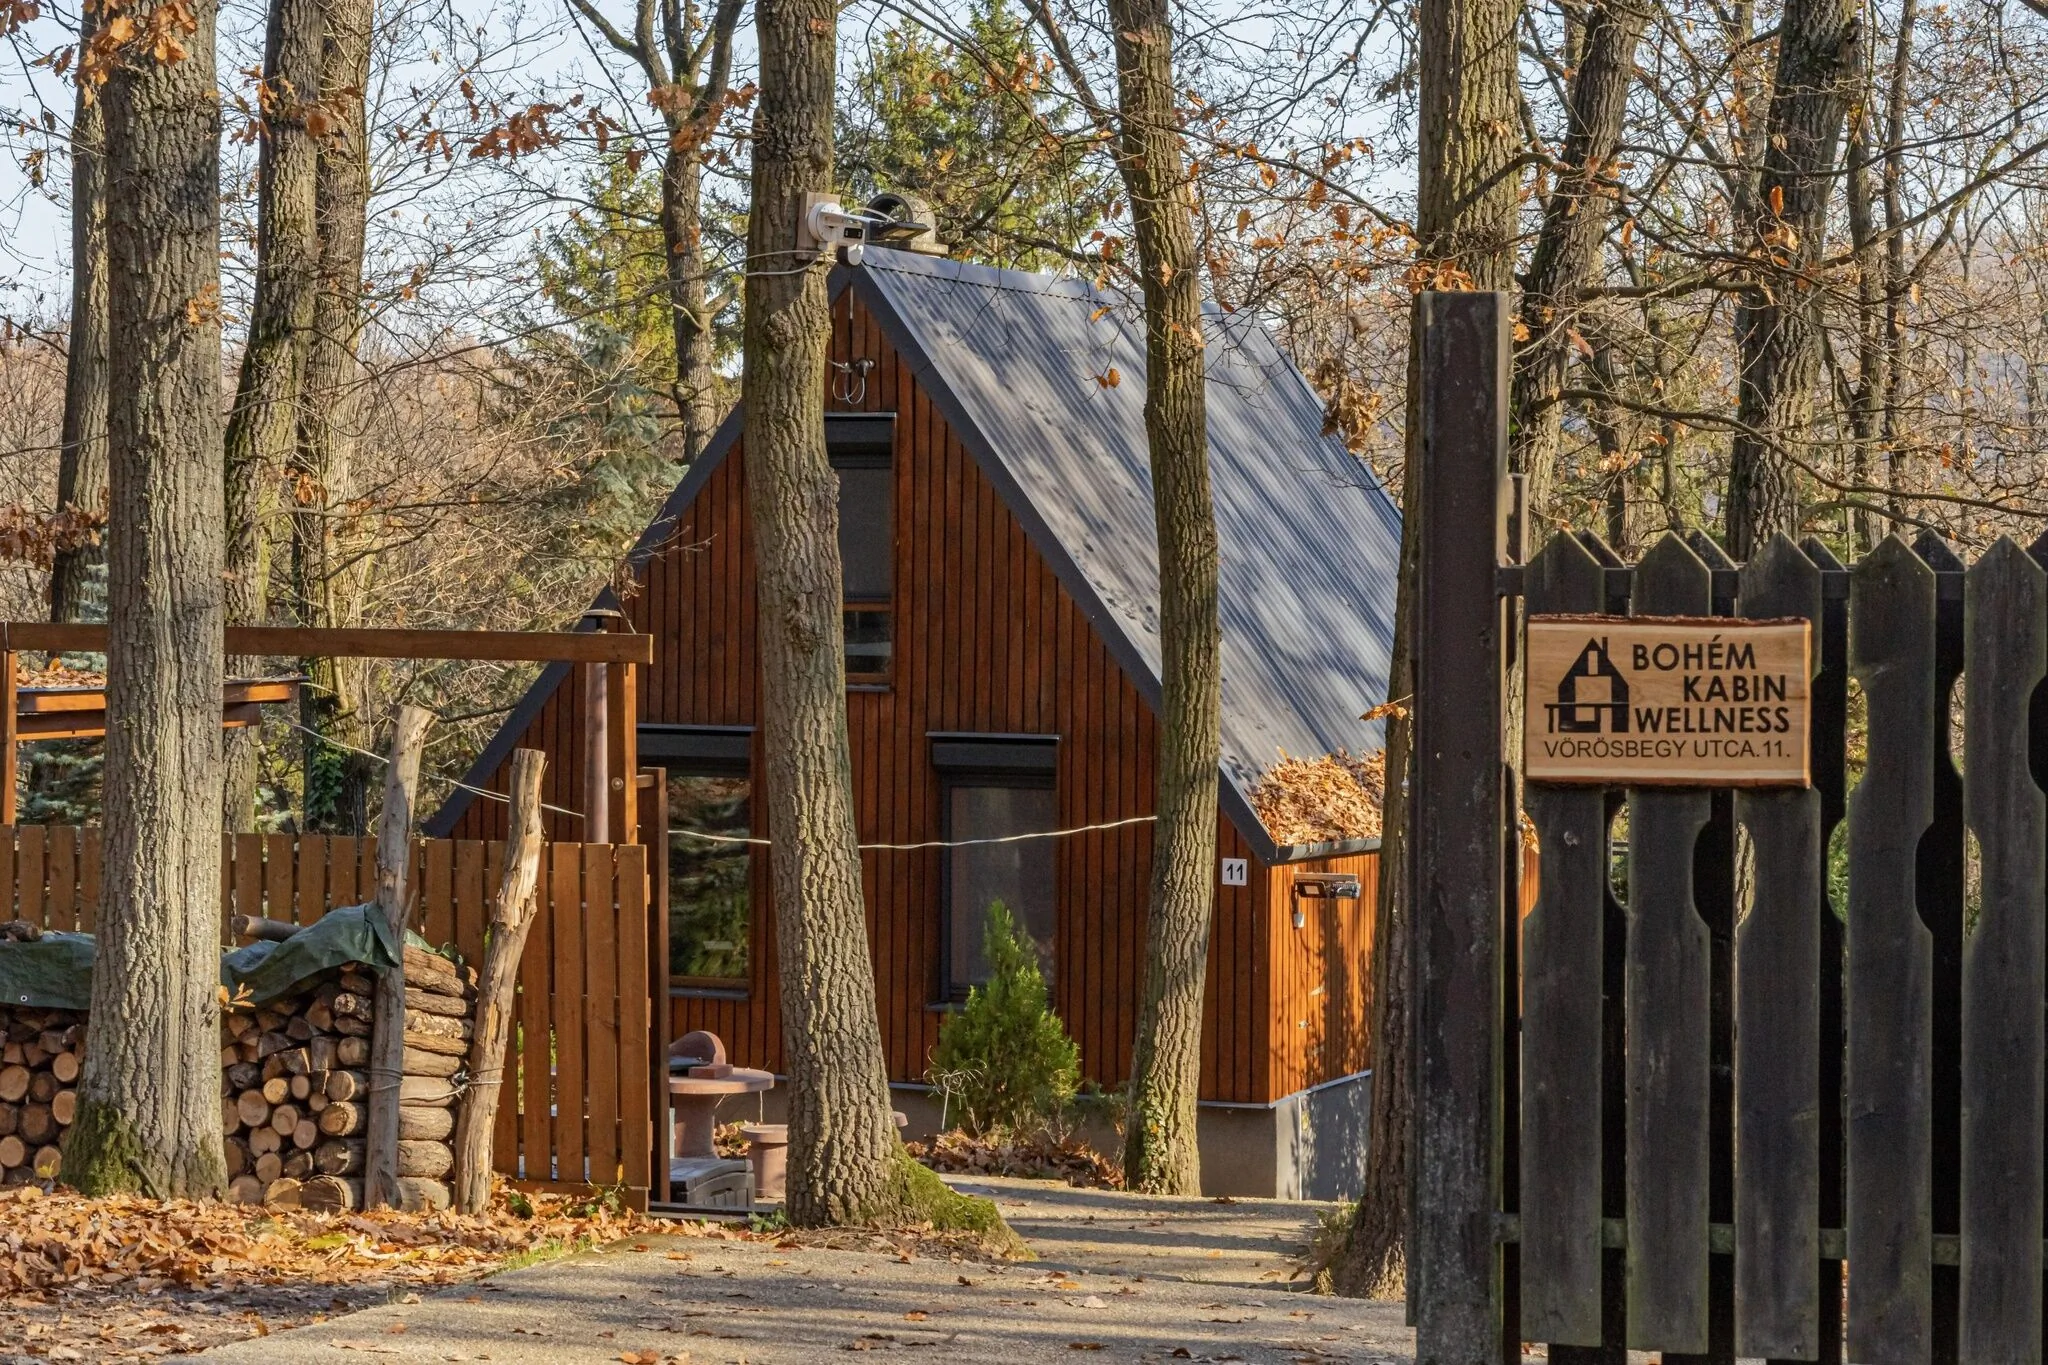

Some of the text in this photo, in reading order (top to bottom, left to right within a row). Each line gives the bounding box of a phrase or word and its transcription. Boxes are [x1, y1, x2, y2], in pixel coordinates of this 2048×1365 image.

[1633, 634, 1757, 671] BOHÉM
[1684, 675, 1786, 702] KABIN
[1635, 707, 1790, 733] WELLNESS
[1544, 737, 1686, 758] VÖRÖSBEGY
[1226, 863, 1243, 881] 11
